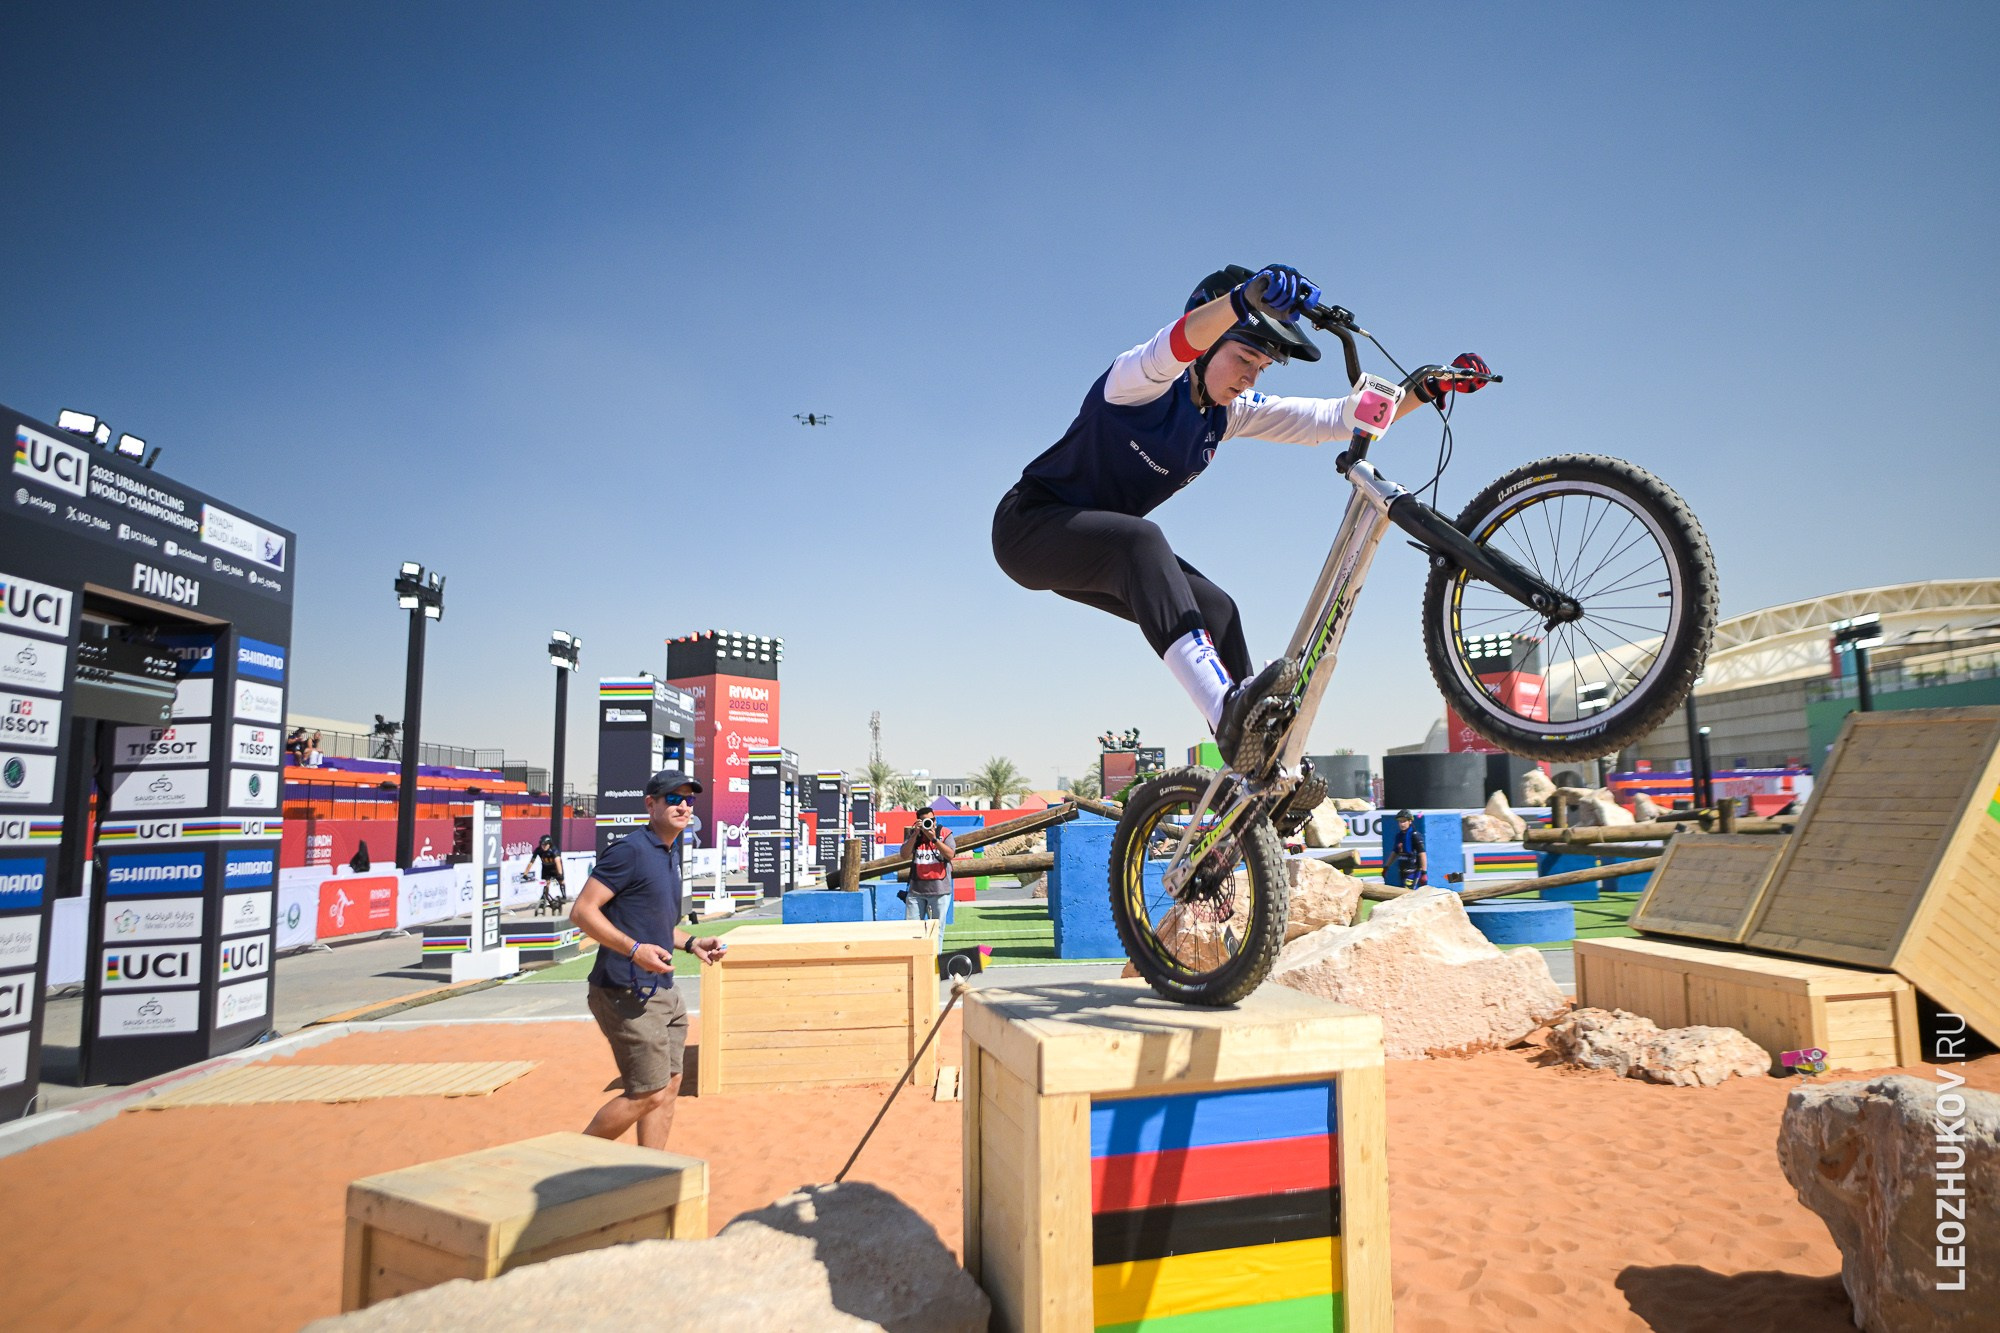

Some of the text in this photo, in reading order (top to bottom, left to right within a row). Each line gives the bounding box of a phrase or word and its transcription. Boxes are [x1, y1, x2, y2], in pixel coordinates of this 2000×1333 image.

[1373, 402, 1388, 423] 3
[30, 439, 83, 486] UCI
[1139, 450, 1169, 476] FACOM
[90, 465, 185, 512] 2025 URBAN CYCLING
[90, 480, 200, 532] WORLD CHAMPIONSHIPS
[209, 512, 234, 531] RIYADH
[208, 527, 230, 543] SAUDI
[132, 562, 200, 605] FINISH
[8, 584, 63, 626] UCI
[238, 648, 284, 670] SHIMANO
[729, 685, 769, 701] RIYADH
[729, 700, 769, 711] 2025 UCI
[0, 715, 49, 734] ISSOT
[127, 742, 197, 756] TISSOT
[240, 742, 274, 756] TISSOT
[243, 821, 262, 836] UCI
[485, 823, 501, 835] START
[615, 816, 632, 824] UCI
[1352, 818, 1382, 837] UC
[139, 823, 178, 839] UCI
[307, 834, 333, 847] RIYADH
[321, 848, 332, 858] UCI
[487, 836, 497, 865] 2
[109, 864, 203, 883] SHIMANO
[225, 860, 273, 877] SHIMANO
[0, 873, 44, 893] MANO
[122, 952, 190, 980] UCI
[231, 942, 264, 971] UCI
[0, 983, 24, 1018] CI
